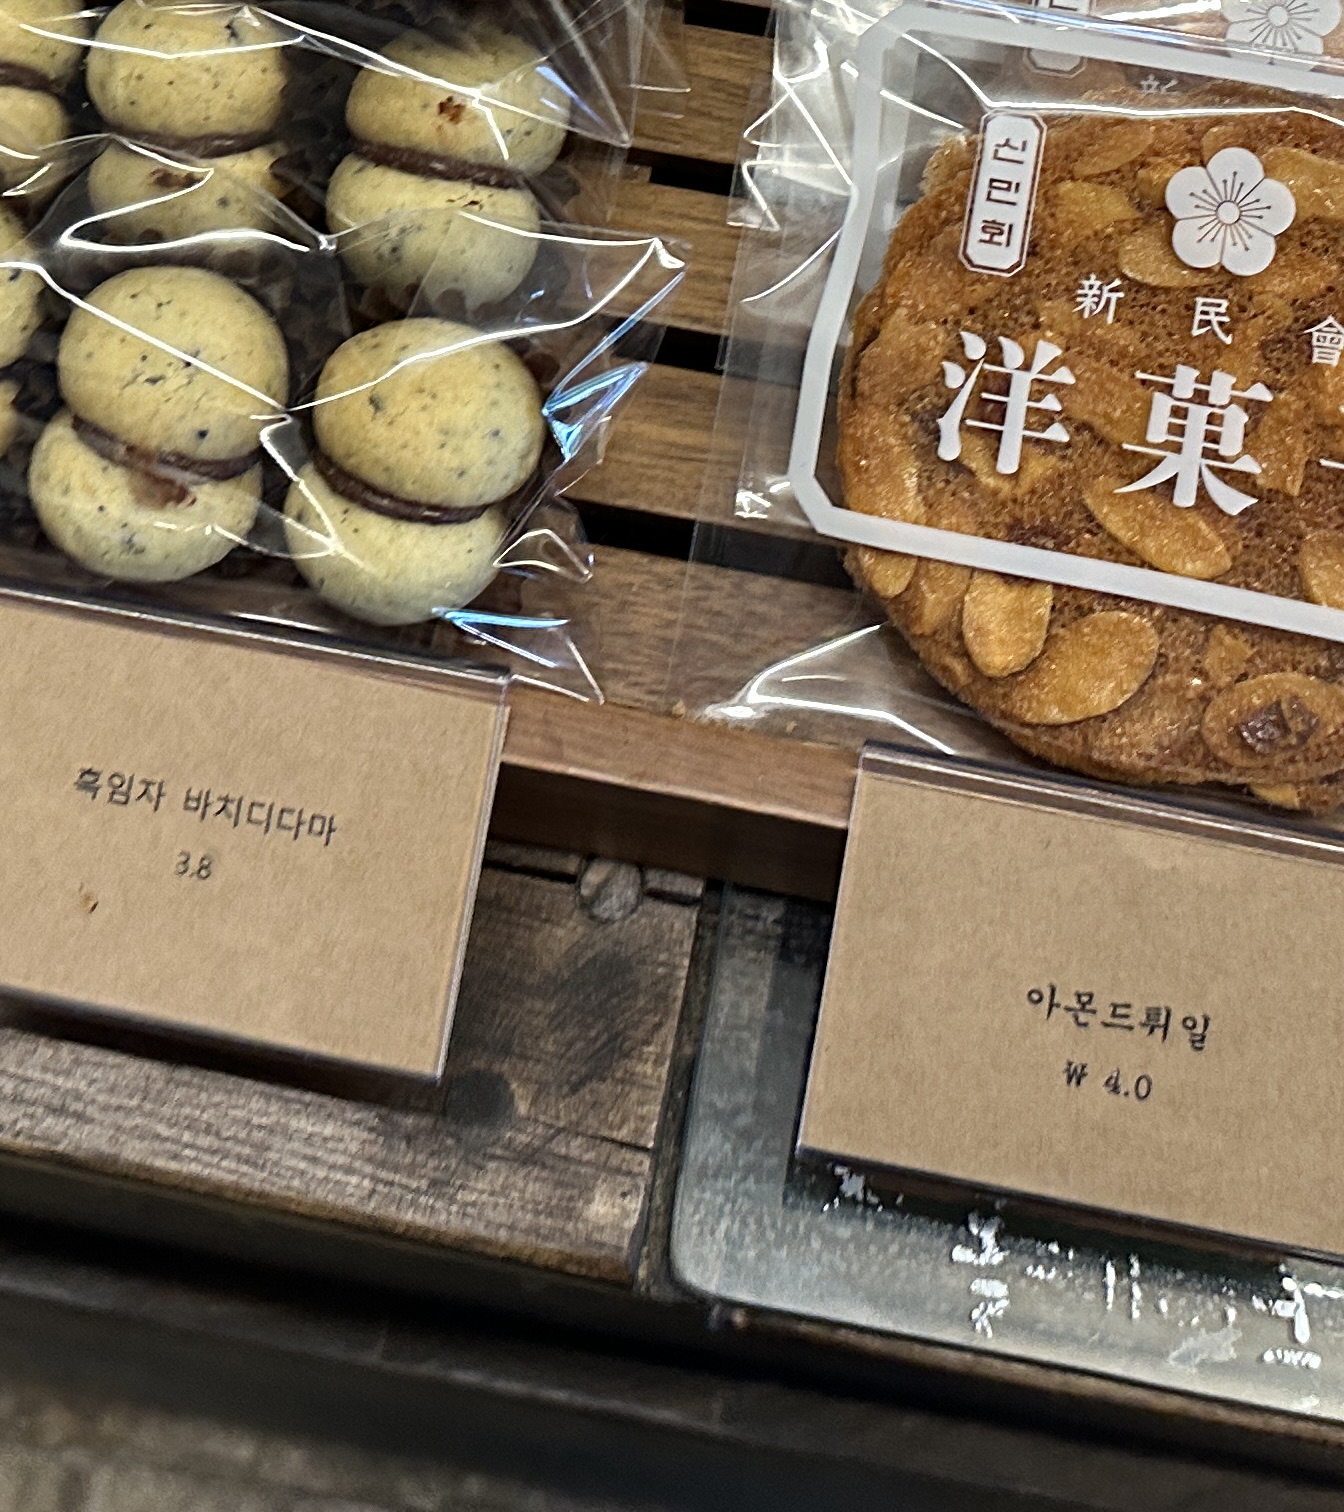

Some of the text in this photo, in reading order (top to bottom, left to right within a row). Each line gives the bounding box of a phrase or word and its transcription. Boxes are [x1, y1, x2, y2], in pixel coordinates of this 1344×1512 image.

[977, 136, 1028, 249] 신민회
[74, 767, 337, 847] 흑임자 바치디다마
[175, 850, 213, 881] 3.8
[1104, 1067, 1154, 1102] 4.0
